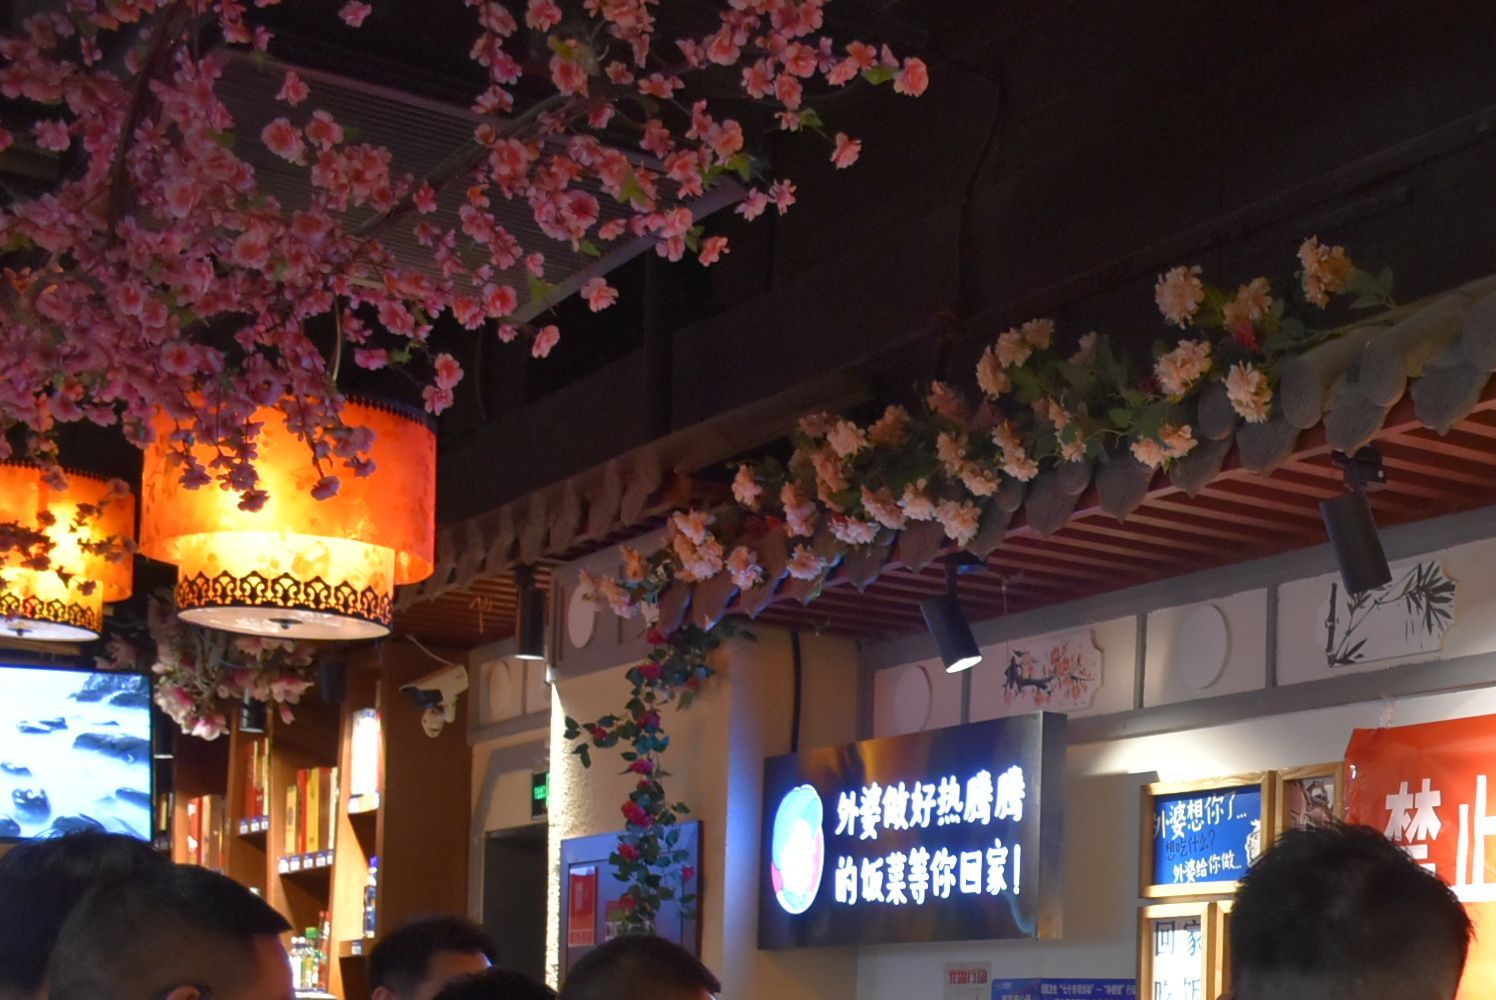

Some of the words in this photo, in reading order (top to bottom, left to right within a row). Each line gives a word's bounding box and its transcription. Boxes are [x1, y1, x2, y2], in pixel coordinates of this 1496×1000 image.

[835, 765, 1025, 840] 外婆做好热腾腾
